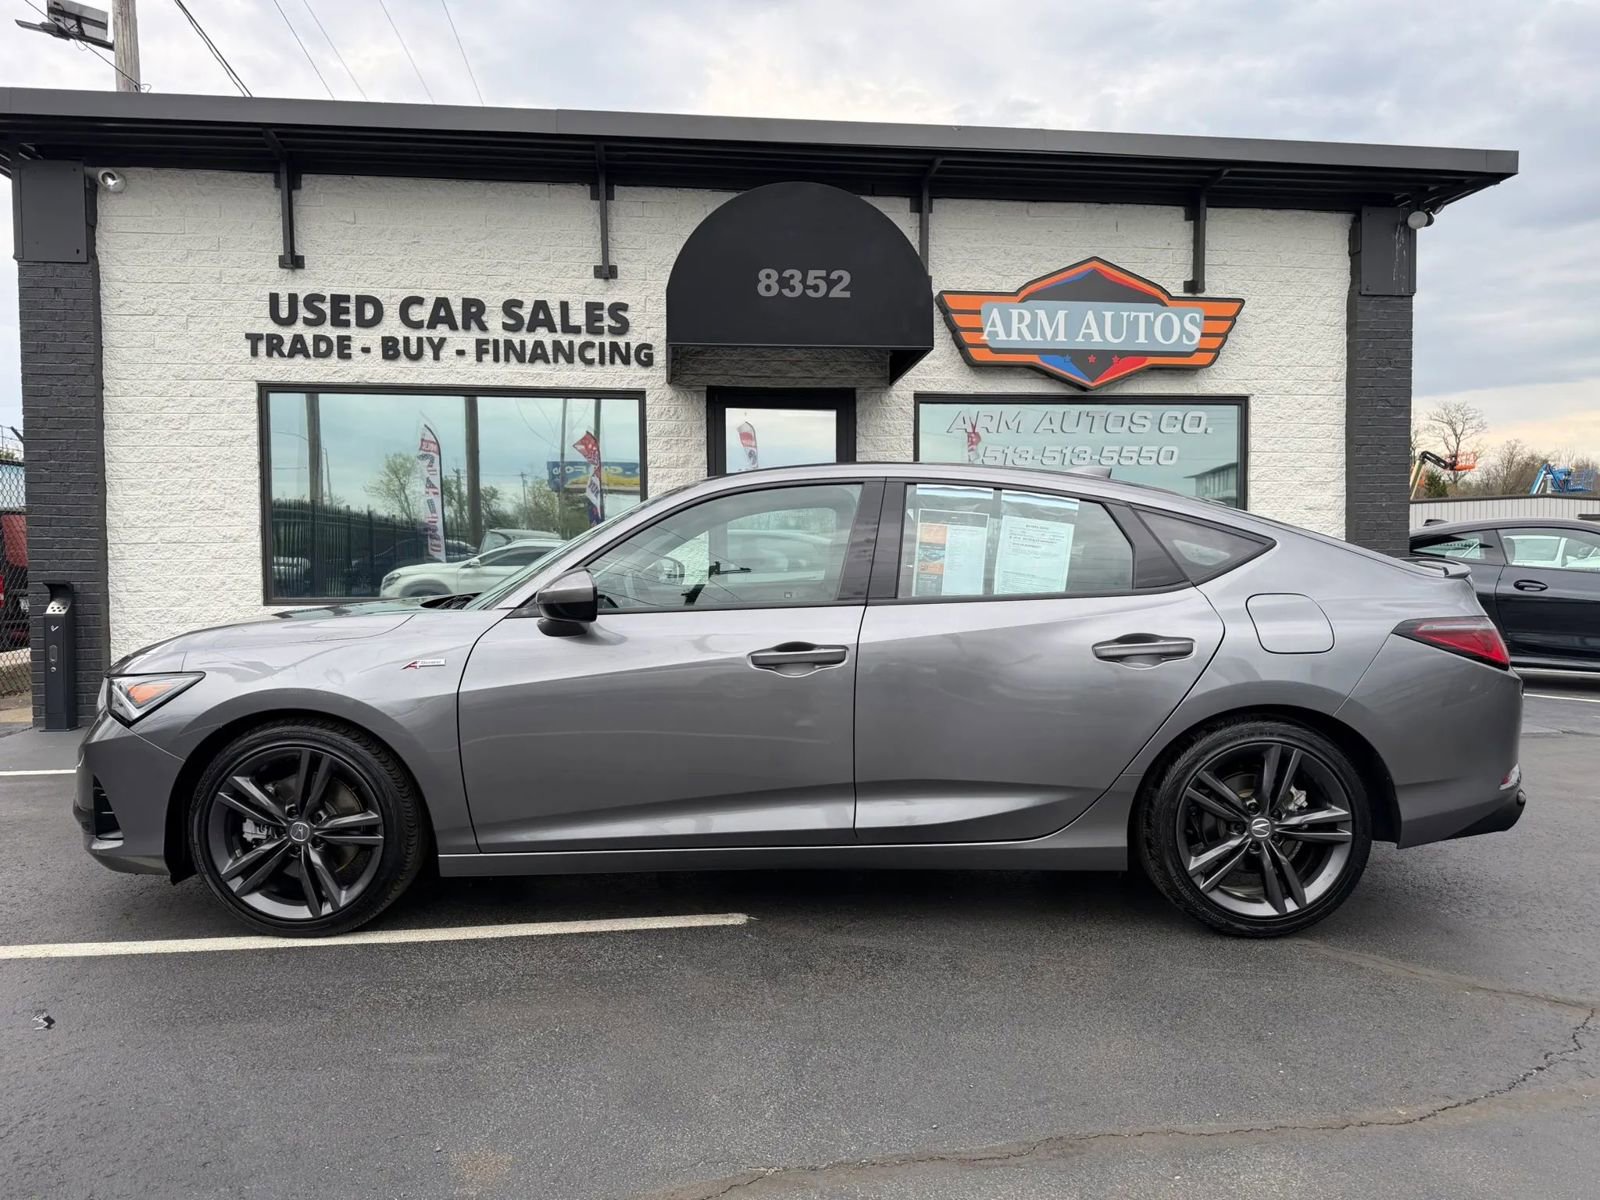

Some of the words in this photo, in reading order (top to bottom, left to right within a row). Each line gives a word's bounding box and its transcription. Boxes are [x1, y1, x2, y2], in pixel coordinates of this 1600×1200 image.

[757, 268, 851, 298] 8352
[268, 292, 384, 328] USED
[400, 296, 489, 331] CAR
[501, 299, 630, 335] SALES
[980, 307, 1068, 342] ARM
[1076, 310, 1203, 345] AUTOS
[245, 332, 353, 360] TRADE
[382, 336, 447, 362] BUY
[475, 338, 654, 367] FINANCING
[947, 410, 1024, 434] ARM
[1034, 410, 1153, 434] AUTOS
[1158, 411, 1214, 434] CO.
[981, 445, 1179, 466] 513-513-5550
